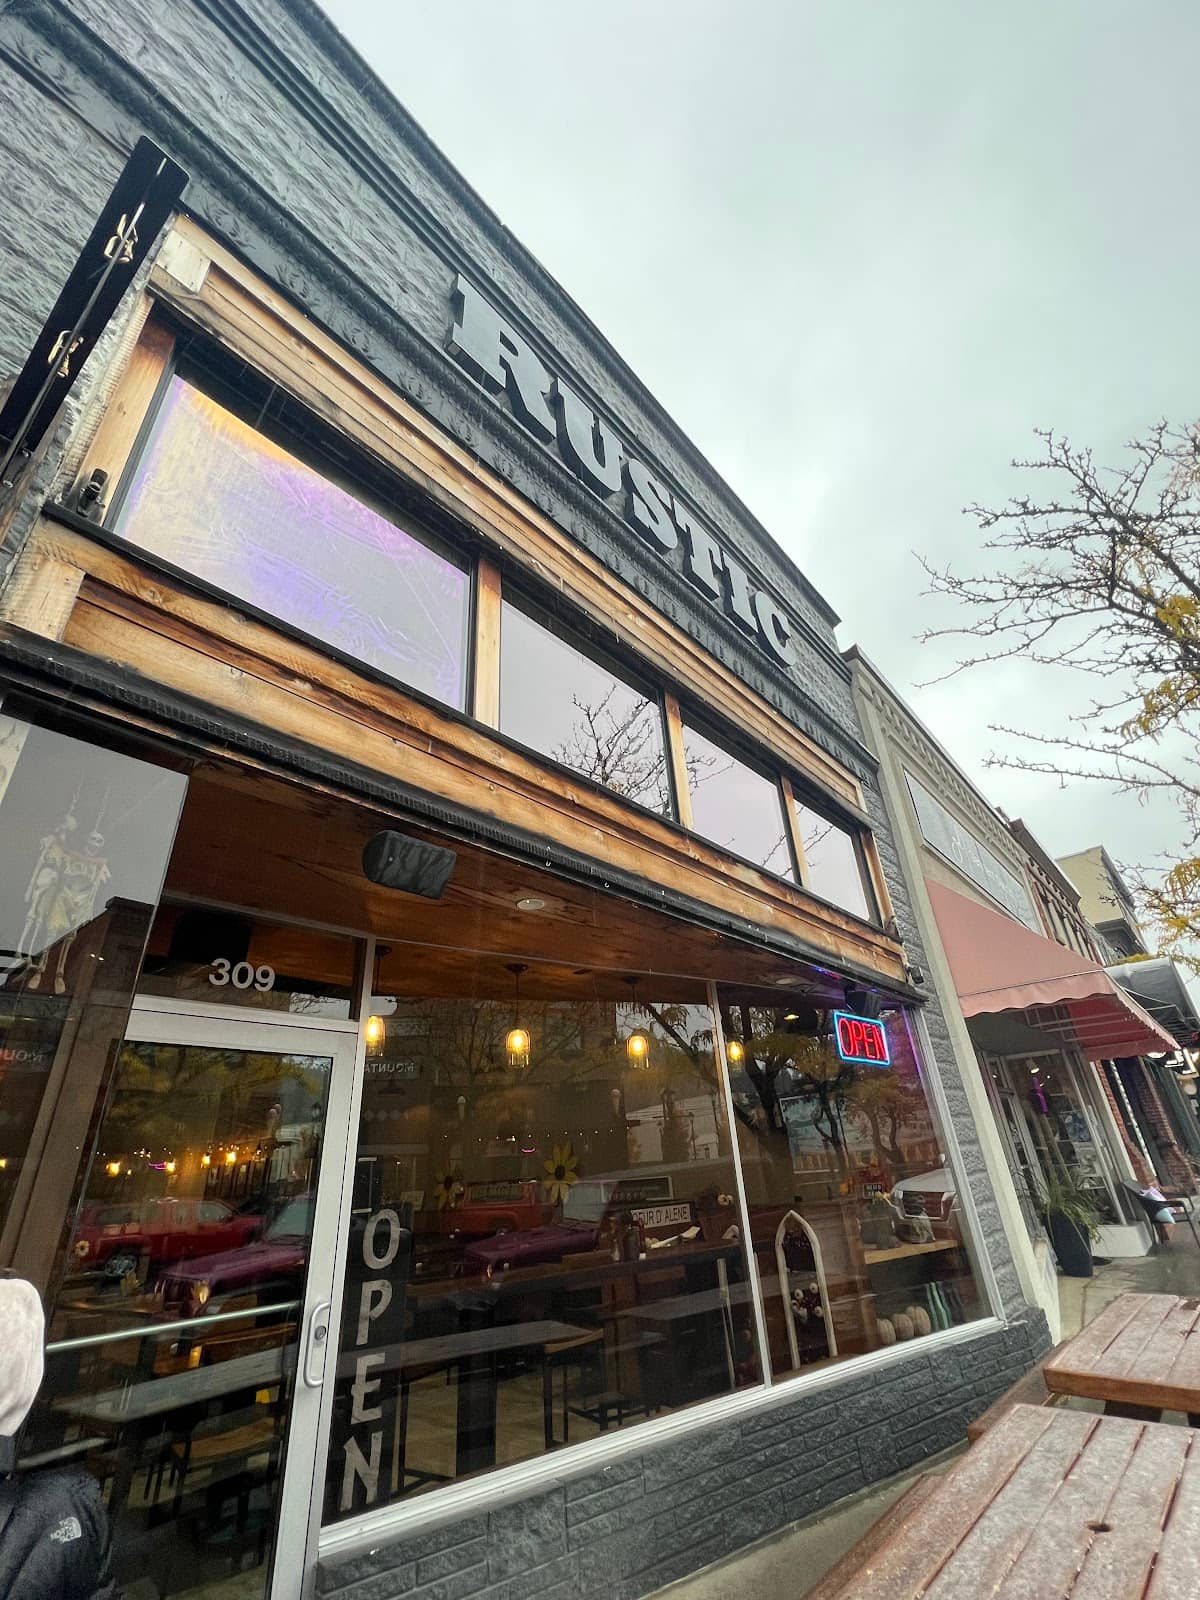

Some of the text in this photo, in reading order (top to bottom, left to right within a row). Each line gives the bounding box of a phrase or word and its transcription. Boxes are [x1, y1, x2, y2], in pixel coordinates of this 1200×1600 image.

[450, 273, 798, 667] RUSTIC
[208, 957, 276, 992] 309
[838, 1017, 887, 1061] OPEN
[339, 1209, 401, 1512] OPEN
